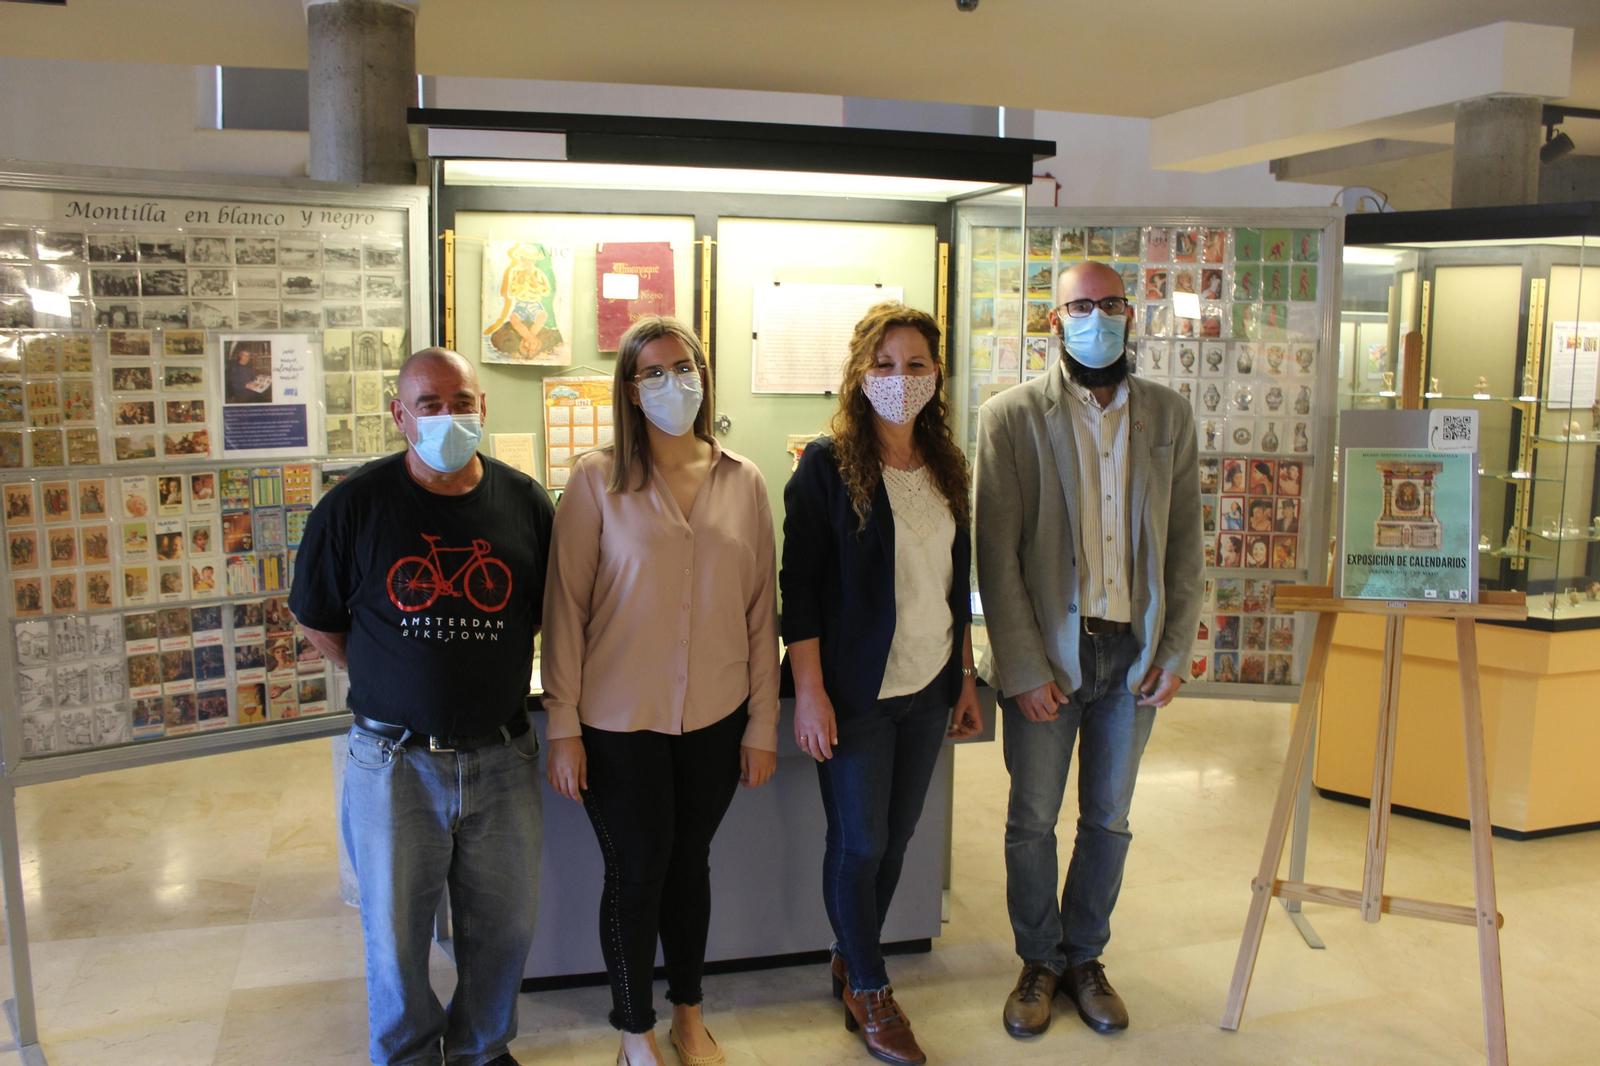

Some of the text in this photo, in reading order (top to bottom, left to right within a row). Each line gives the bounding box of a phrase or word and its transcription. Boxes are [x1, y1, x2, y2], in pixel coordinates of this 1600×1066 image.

[65, 201, 374, 230] Montilla en blanco y negro
[1347, 552, 1466, 568] EXPOSICIÓN DE CALENDARIOS
[400, 617, 504, 629] AMSTERDAM
[402, 629, 498, 641] BIKETOWN
